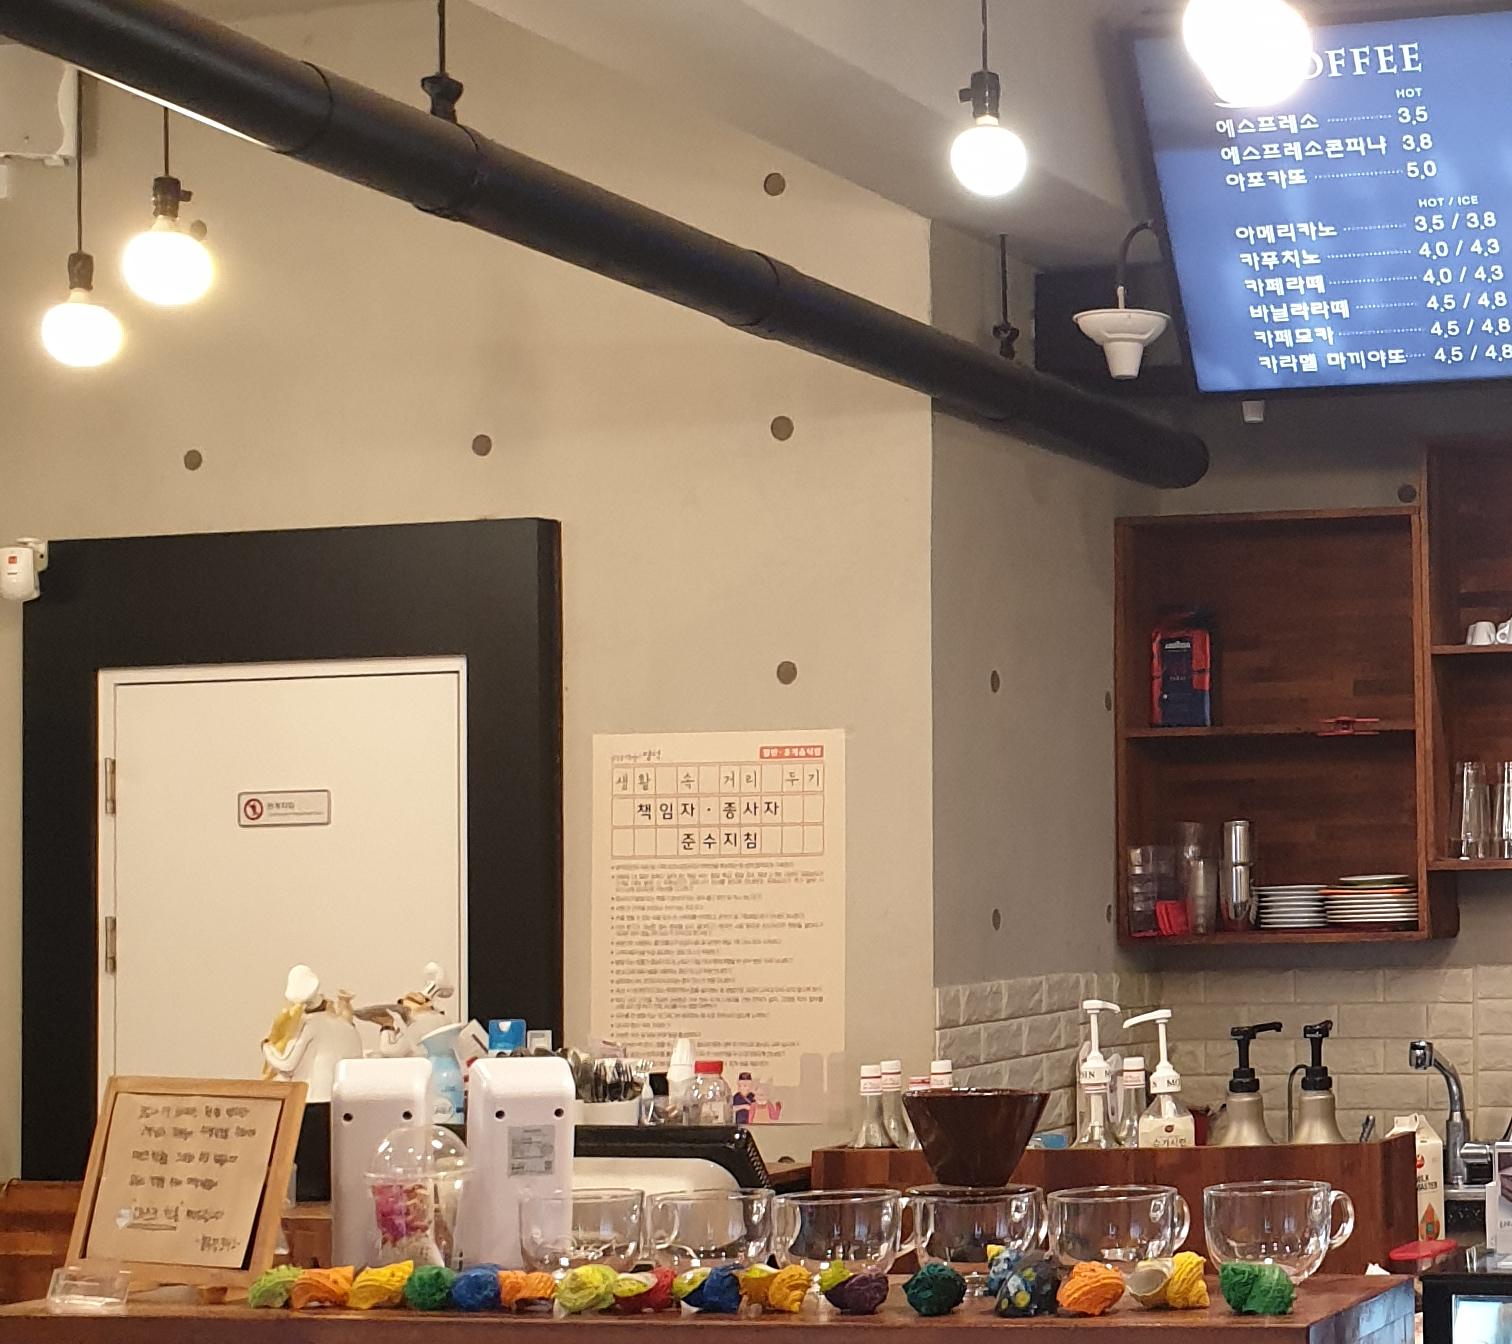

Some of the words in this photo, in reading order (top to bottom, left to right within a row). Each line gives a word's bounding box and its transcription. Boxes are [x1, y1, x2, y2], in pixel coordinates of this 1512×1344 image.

[1395, 87, 1422, 99] HOT
[1215, 111, 1319, 138] 에스프레소
[1397, 105, 1428, 125] 3.5
[1402, 133, 1433, 152] 3.8
[1225, 168, 1308, 192] 아포카또
[1407, 160, 1437, 180] 5.0
[1418, 197, 1445, 208] HOT
[1457, 195, 1479, 206] ICE
[1235, 221, 1337, 244] 아메리카노
[1414, 214, 1445, 233] 3.5
[1466, 211, 1497, 230] 3.8
[1239, 249, 1321, 272] 카푸치노
[1418, 241, 1449, 260] 4.0
[1470, 238, 1500, 257] 4.3
[1422, 267, 1452, 286] 4.0
[1474, 264, 1504, 283] 4.3
[1249, 299, 1350, 323] 바닐라라떼
[1426, 294, 1456, 313] 4.5
[1477, 291, 1508, 310] 4.8
[1254, 326, 1334, 348] 카페모카
[1430, 320, 1460, 338] 4.5
[1481, 317, 1511, 336] 4.8
[1258, 353, 1318, 374] 카라멜
[1326, 349, 1407, 370] 마끼아또
[1434, 346, 1463, 364] 4.5
[680, 772, 695, 789] 속
[723, 770, 757, 788] 거리
[681, 832, 757, 850] 준수지침
